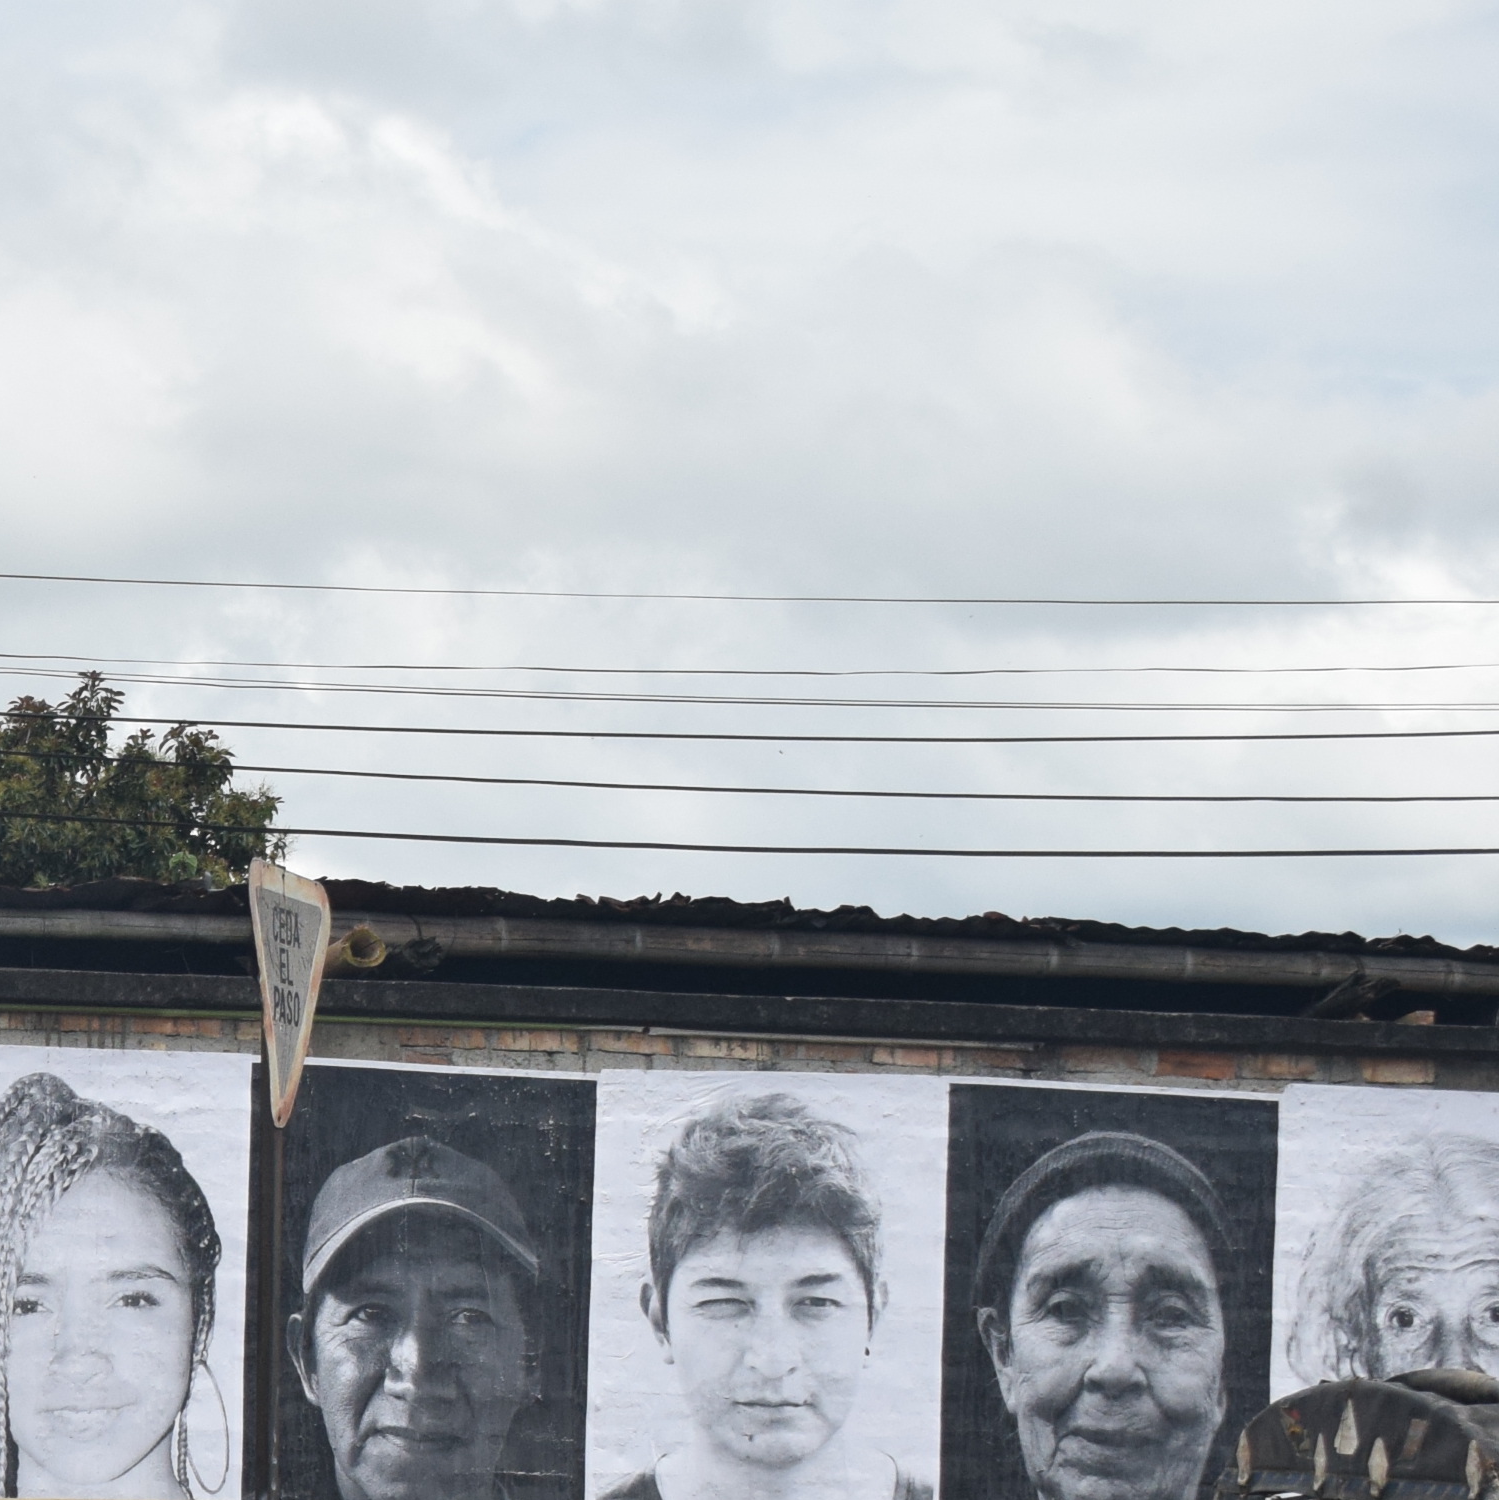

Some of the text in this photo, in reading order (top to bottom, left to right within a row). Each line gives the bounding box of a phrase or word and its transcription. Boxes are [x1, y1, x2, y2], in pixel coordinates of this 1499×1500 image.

[272, 907, 301, 949] CEDA
[279, 948, 294, 986] EL
[273, 985, 300, 1028] PASO
